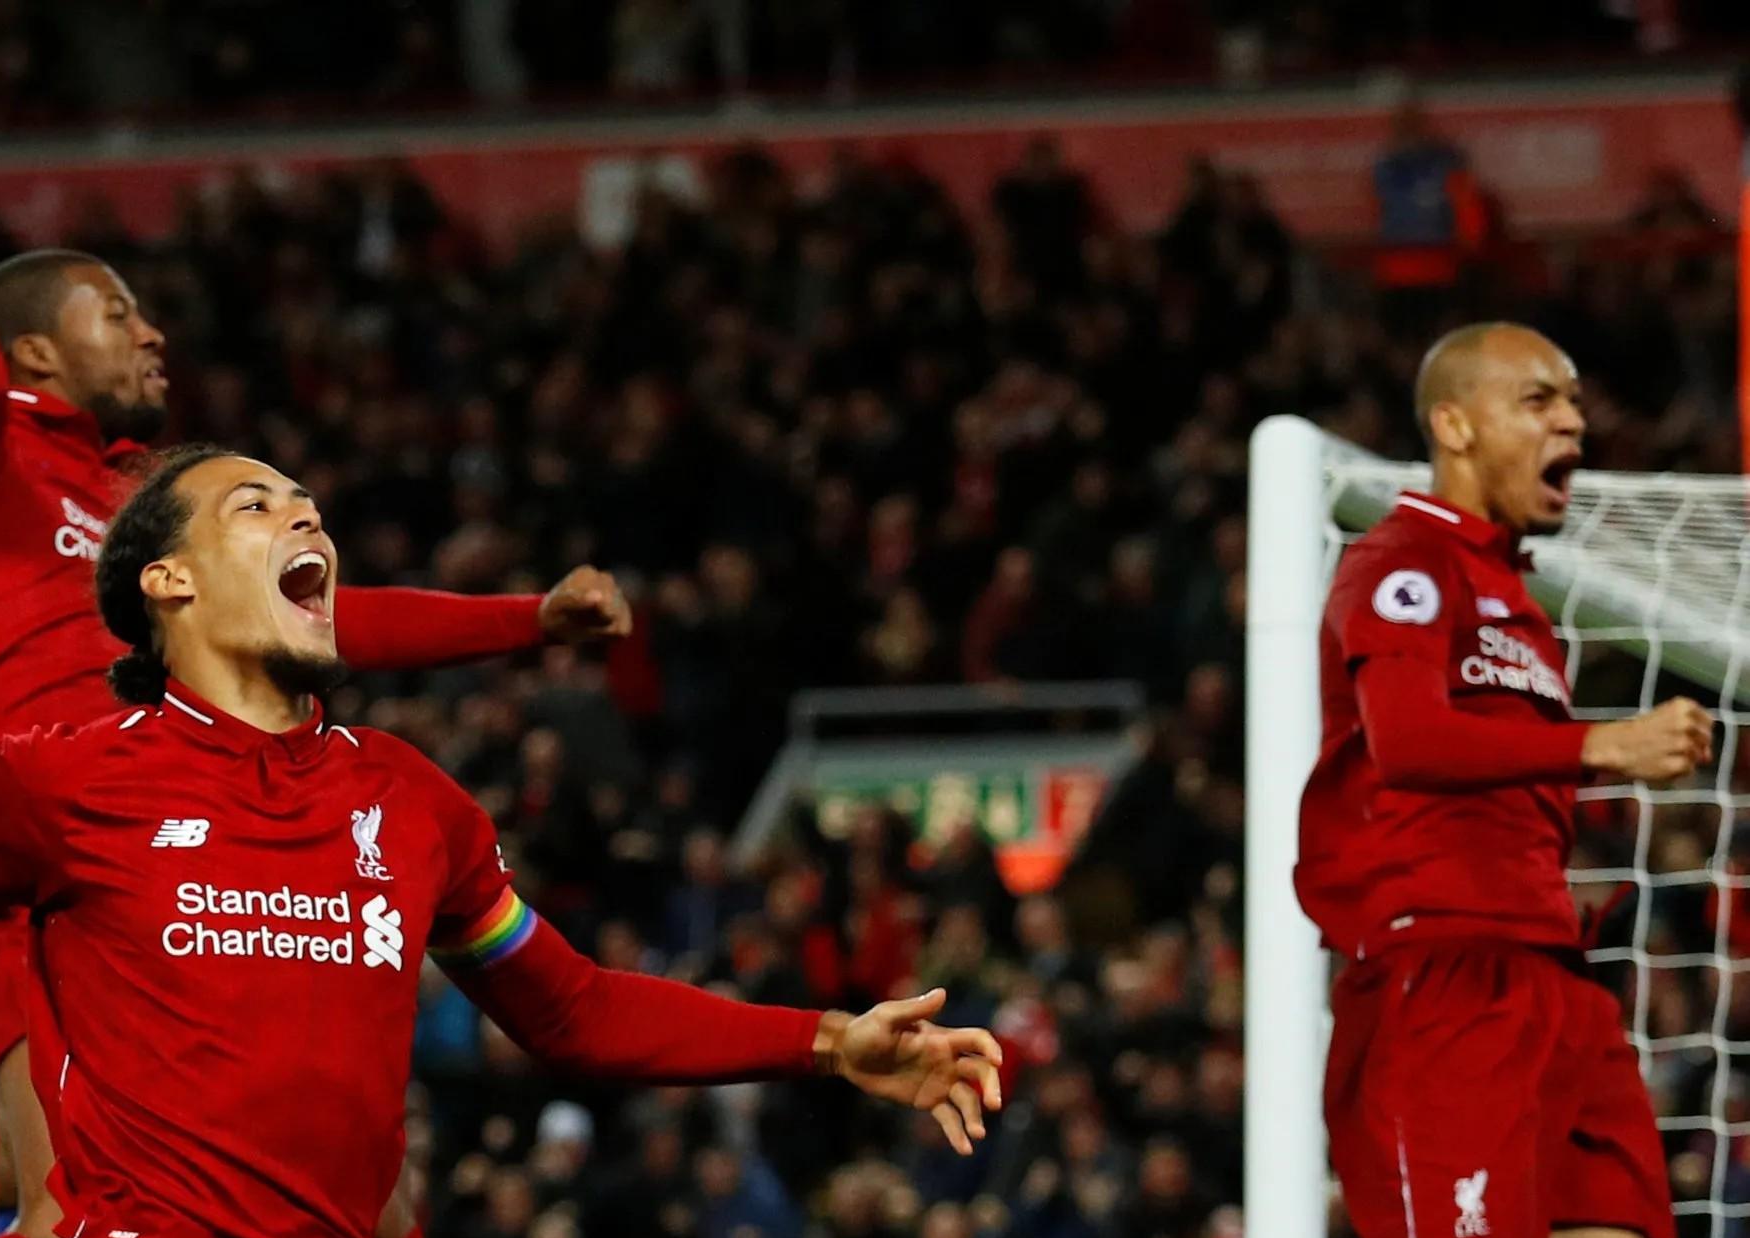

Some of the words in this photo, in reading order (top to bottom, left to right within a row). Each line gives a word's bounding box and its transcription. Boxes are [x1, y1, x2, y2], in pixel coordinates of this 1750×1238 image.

[151, 818, 210, 848] NB
[176, 882, 351, 923] Standard
[162, 922, 352, 965] Chartered
